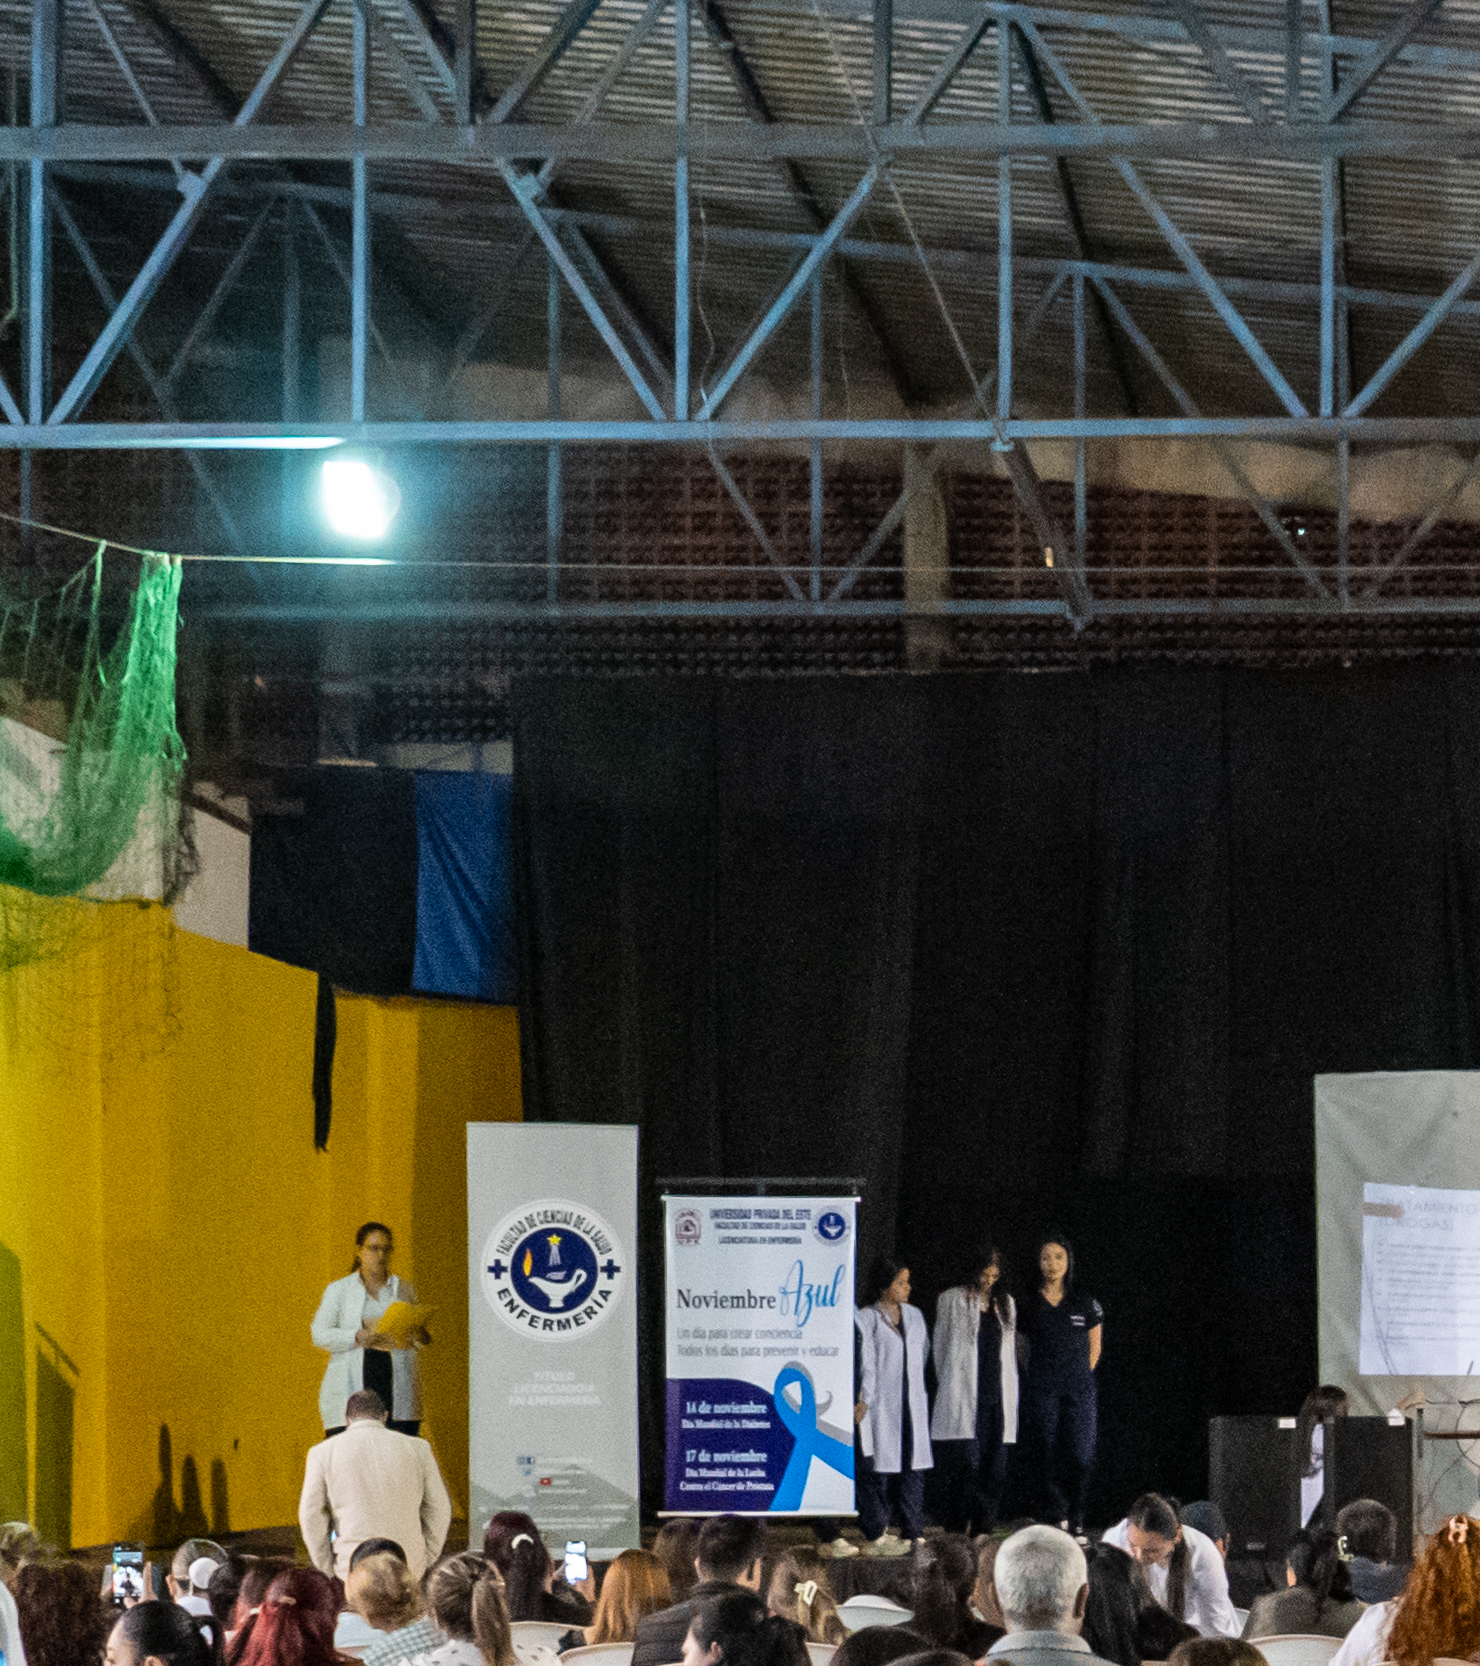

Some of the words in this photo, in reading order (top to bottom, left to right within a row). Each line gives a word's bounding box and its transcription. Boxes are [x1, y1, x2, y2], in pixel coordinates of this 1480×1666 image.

[676, 1288, 777, 1310] Noviembre
[779, 1259, 846, 1328] Azul
[713, 1400, 768, 1414] noviembre
[686, 1449, 697, 1462] 17
[698, 1449, 711, 1462] de
[713, 1448, 768, 1462] noviembre
